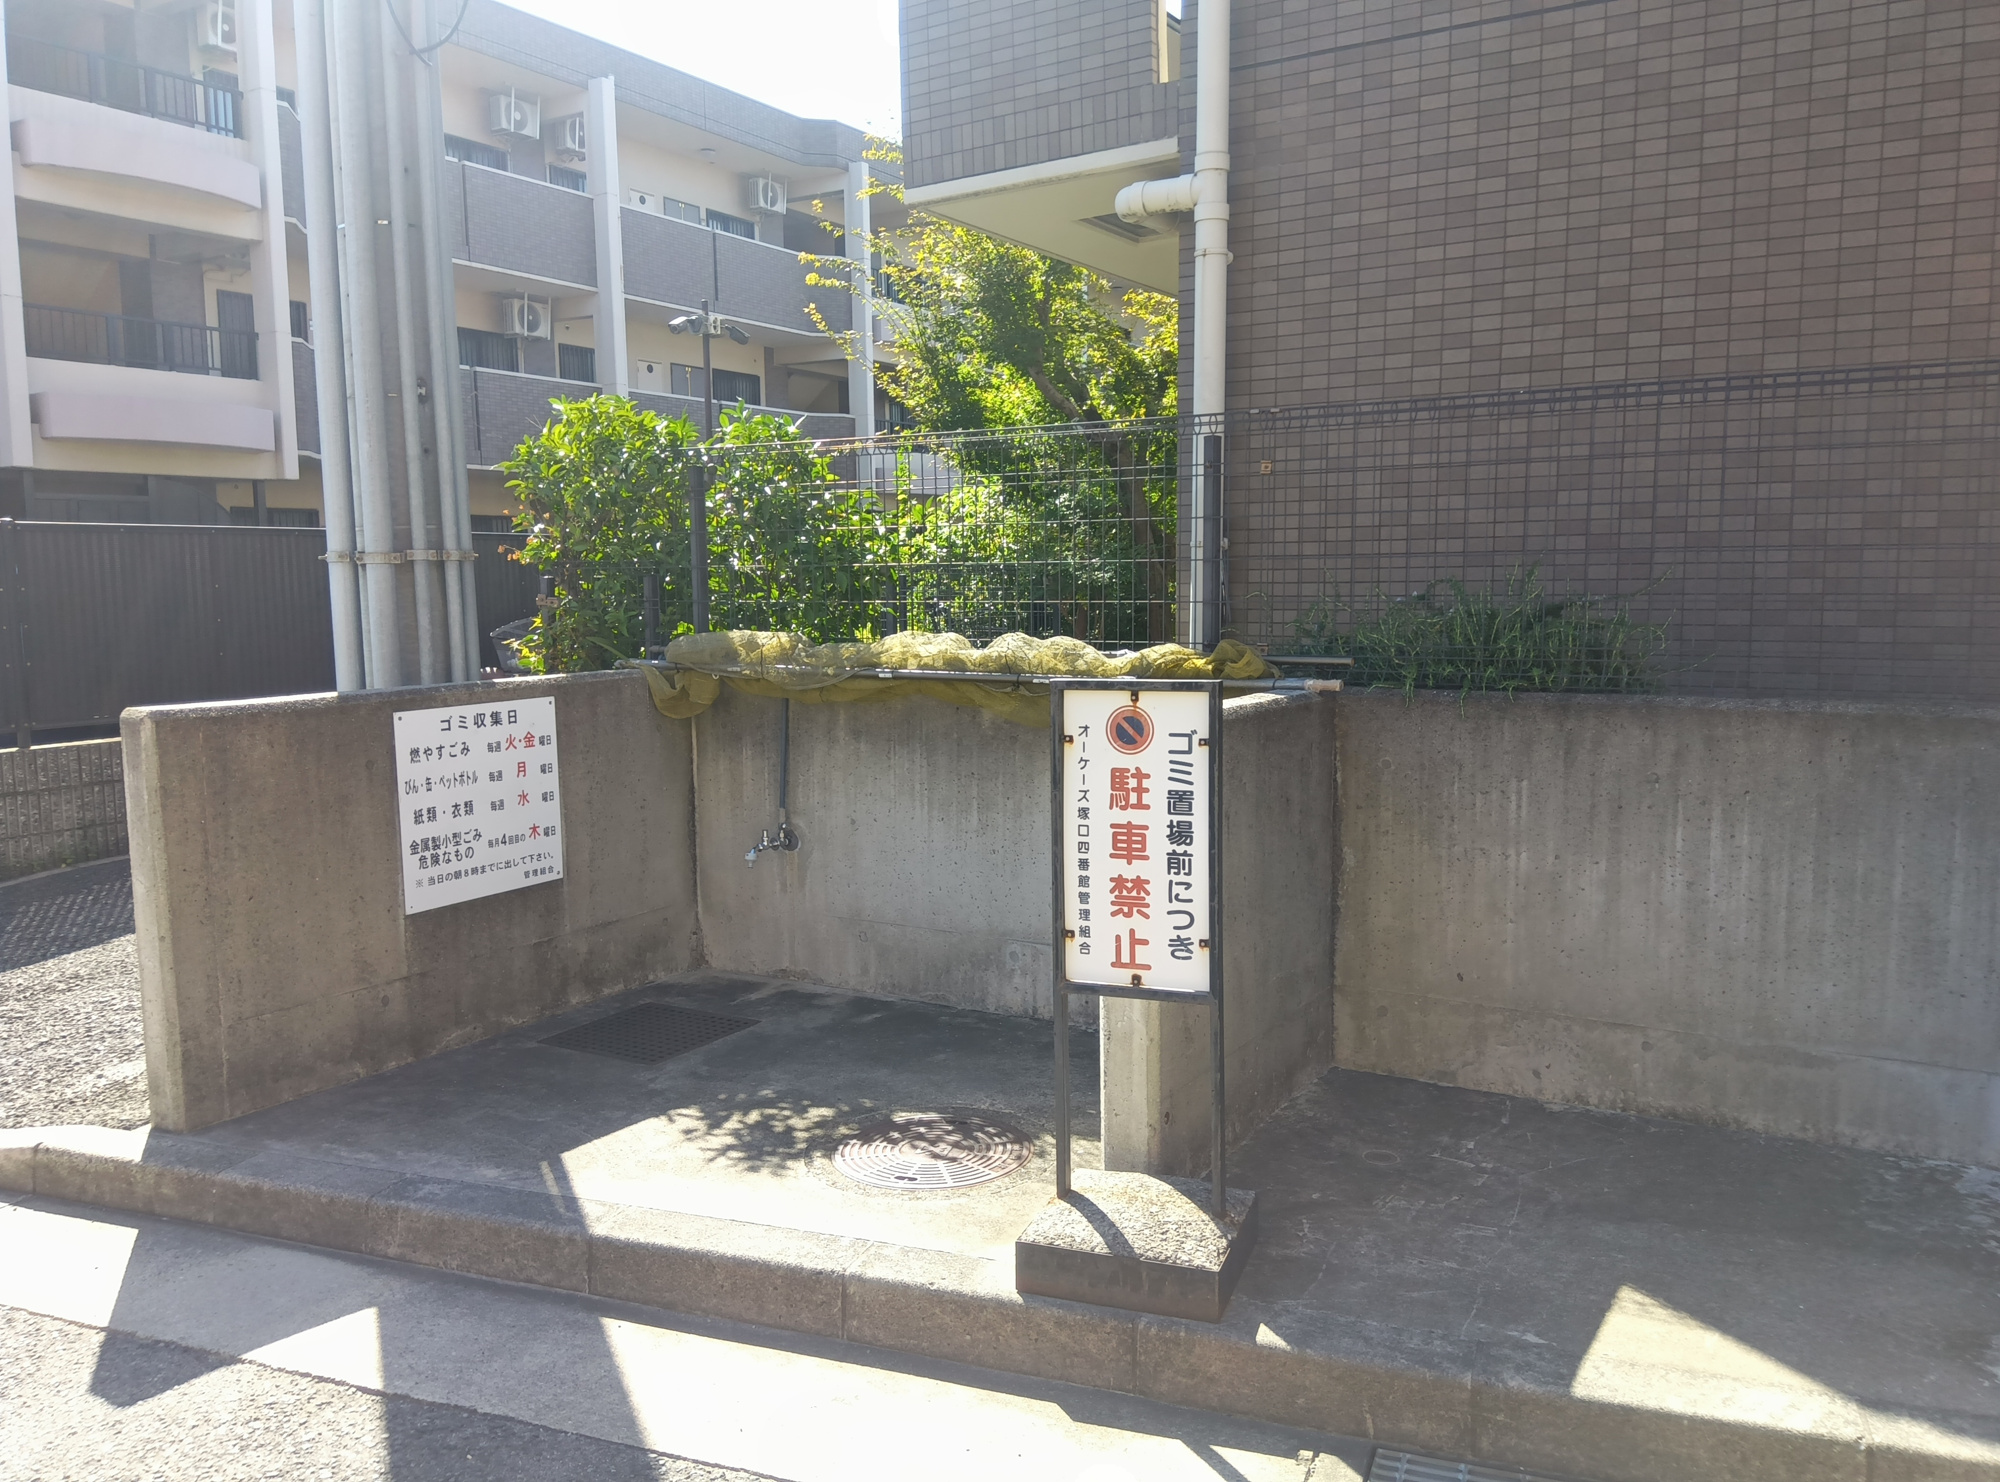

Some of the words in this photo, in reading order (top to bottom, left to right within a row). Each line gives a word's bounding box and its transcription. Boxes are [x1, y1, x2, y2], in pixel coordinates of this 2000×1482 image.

[440, 710, 518, 732] ゴミ収集日
[410, 742, 470, 764] 燃やすごみ
[487, 741, 501, 753] 毎週
[505, 731, 535, 751] 火・金
[539, 735, 551, 746] 曜日
[404, 770, 478, 795] びん・缶・ペットボトル
[489, 770, 503, 783] 毎週
[516, 761, 526, 778] 月
[540, 763, 553, 774] 曜日
[413, 800, 474, 825] 紙類・衣類
[490, 799, 504, 811] 毎週
[518, 790, 530, 807] 水
[542, 791, 554, 803] 曜日
[409, 828, 482, 855] 金属製小型ごみ
[488, 833, 526, 849] 毎月4回目の
[529, 824, 541, 840] 木
[543, 826, 556, 837] 曜日
[1077, 724, 1091, 955] オーケーズ塚口四番館管理組合
[1166, 729, 1198, 961] ゴミ置場前につき
[418, 846, 475, 870] 危険なもの
[524, 865, 554, 879] 管理組合
[1109, 766, 1152, 971] 駐車禁止
